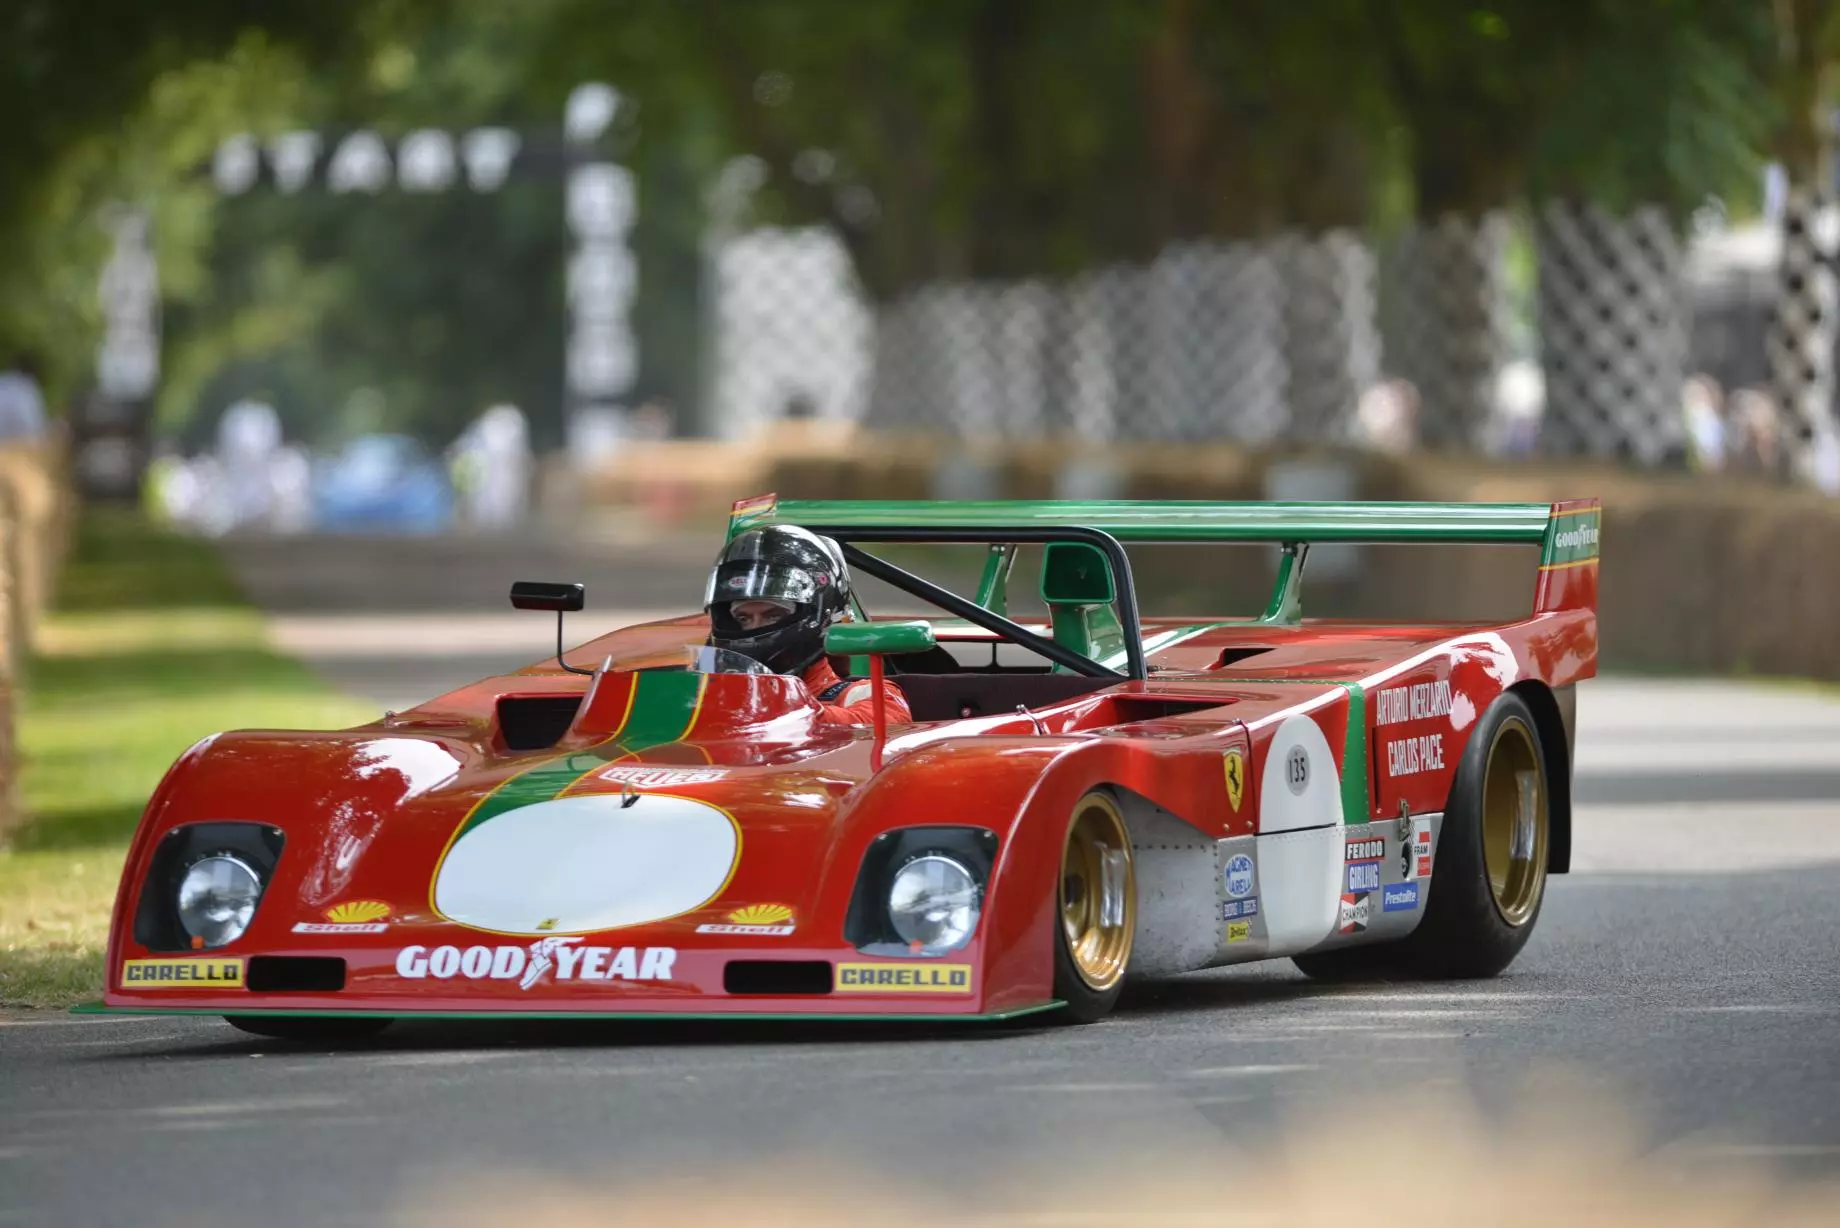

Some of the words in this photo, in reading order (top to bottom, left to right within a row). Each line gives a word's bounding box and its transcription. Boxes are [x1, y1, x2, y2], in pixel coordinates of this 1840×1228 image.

[1388, 739, 1419, 777] CARLOS
[1420, 734, 1445, 771] PACE
[1289, 756, 1306, 783] 135
[1347, 841, 1383, 860] FERODO
[1414, 845, 1428, 855] FRAM
[1349, 865, 1379, 890] GIRLING
[127, 965, 239, 981] CARELLO
[841, 969, 967, 987] CARELLO
